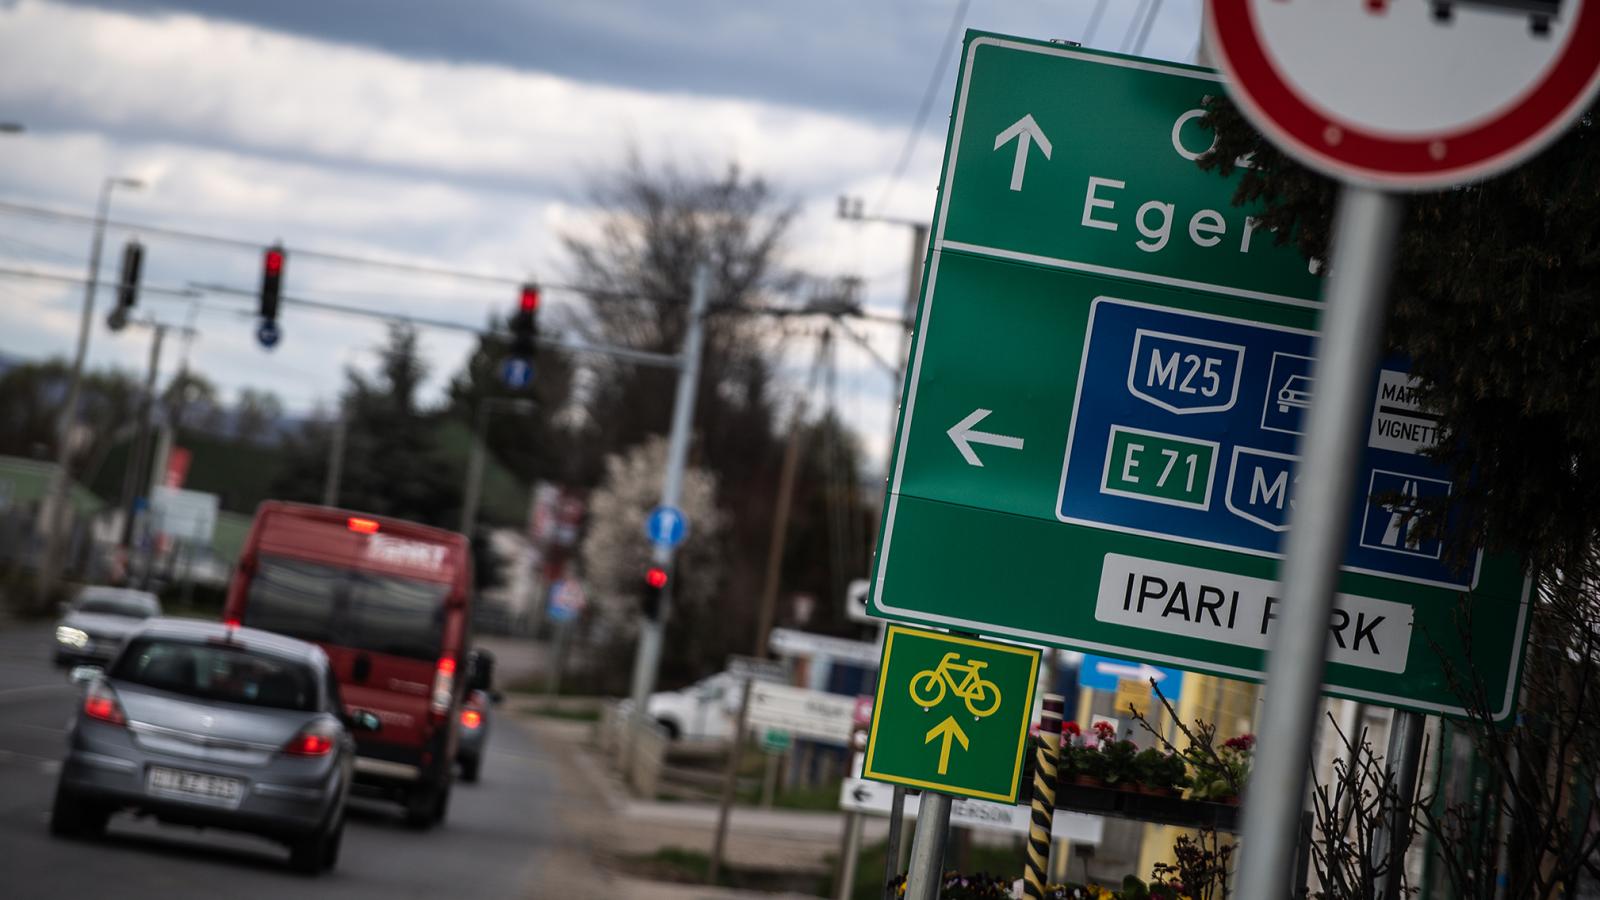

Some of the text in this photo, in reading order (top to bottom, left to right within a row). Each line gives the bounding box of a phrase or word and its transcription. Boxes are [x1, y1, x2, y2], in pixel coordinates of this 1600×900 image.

[1081, 176, 1263, 253] Eger
[1147, 348, 1222, 397] M25
[1121, 442, 1198, 492] E 71
[1123, 572, 1386, 655] IPARI PRK
